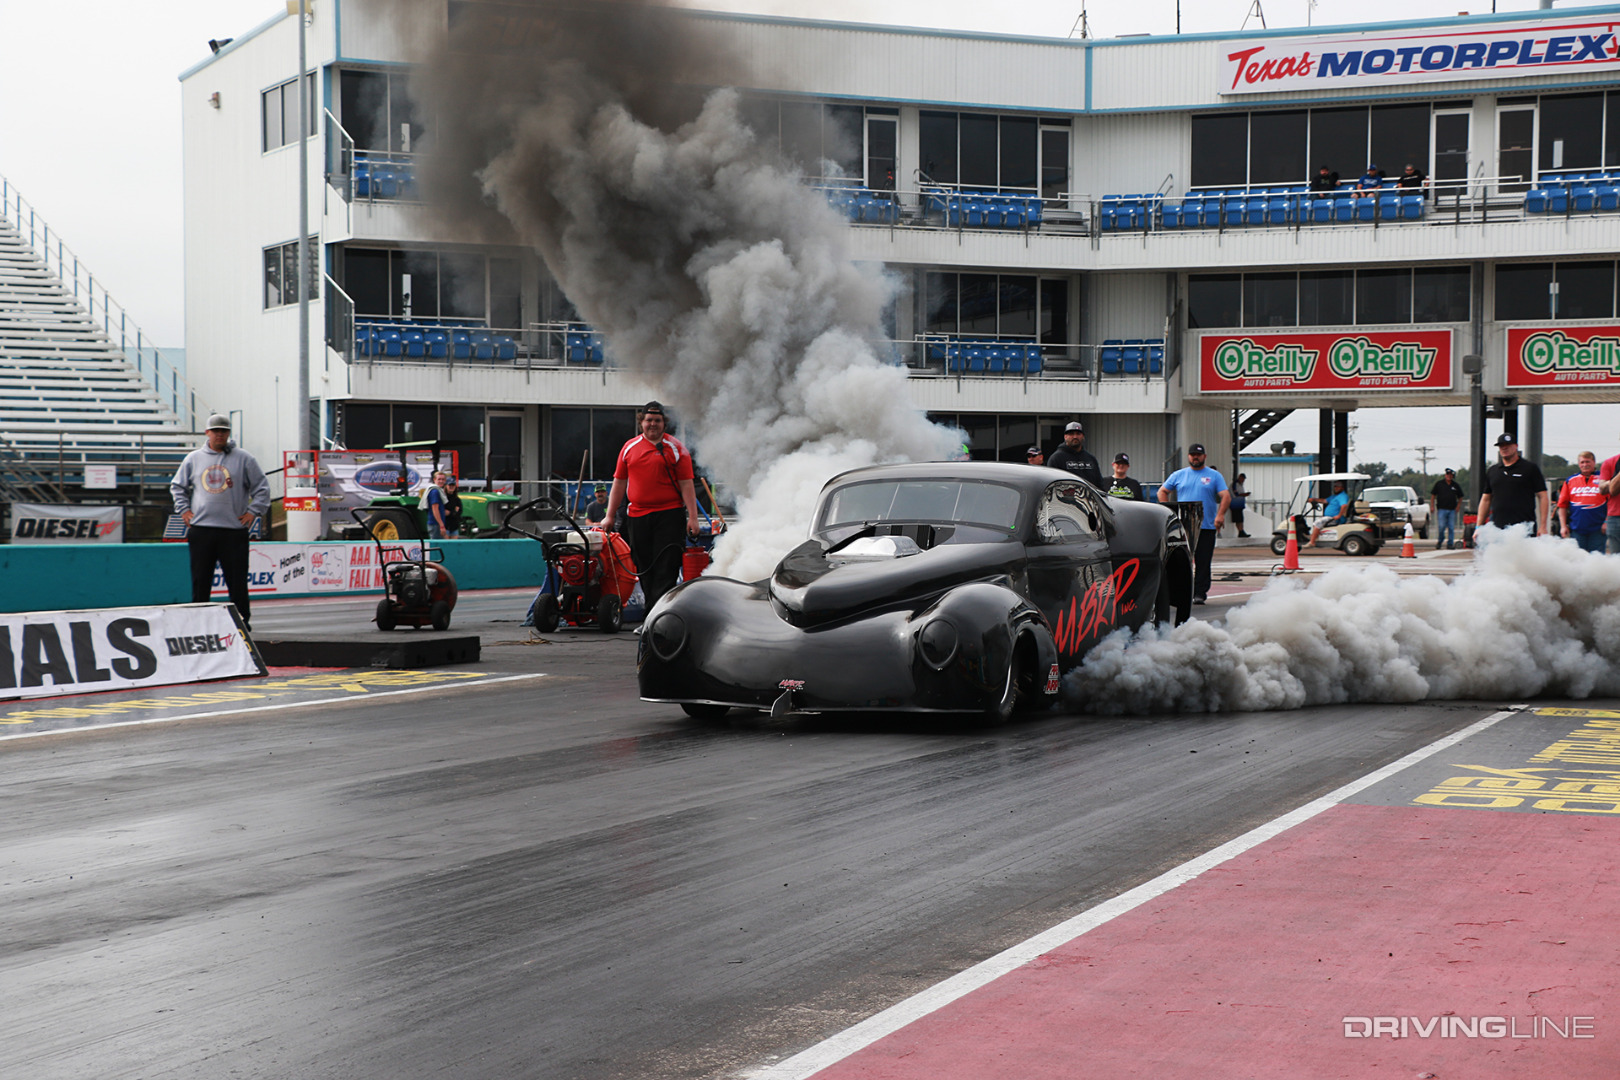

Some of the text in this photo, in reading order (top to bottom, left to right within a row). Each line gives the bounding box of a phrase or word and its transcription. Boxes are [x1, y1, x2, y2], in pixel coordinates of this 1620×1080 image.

[1228, 33, 1615, 90] Texas MOTORPLEX
[1219, 344, 1312, 375] O'Reilly
[1334, 342, 1429, 375] O'Reilly
[1244, 378, 1291, 387] AUTO PARTS
[1359, 377, 1408, 386] AUTO PARTS
[1554, 372, 1607, 381] AUTO PARTS
[14, 517, 100, 538] DIESEL
[280, 552, 301, 569] Home
[350, 546, 370, 566] AAA
[283, 565, 305, 583] of the
[349, 568, 370, 588] FALL
[1054, 558, 1140, 656] MBRP
[165, 634, 227, 656] DIESEL
